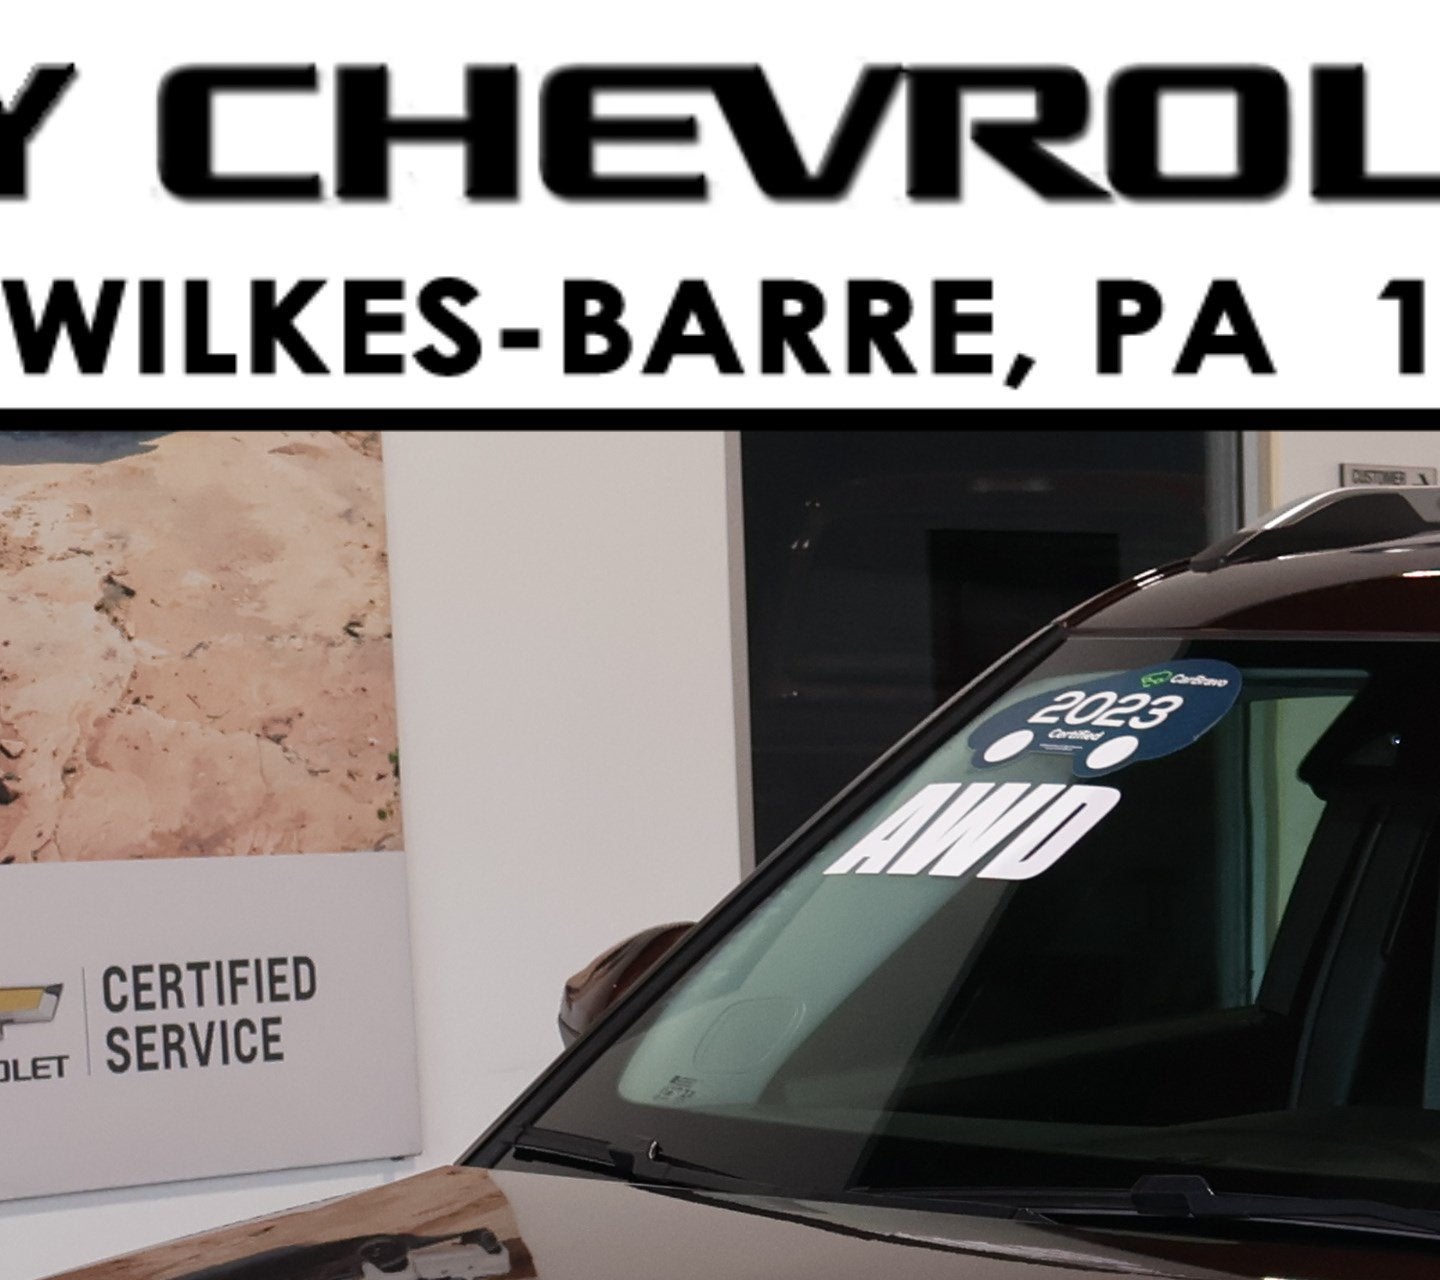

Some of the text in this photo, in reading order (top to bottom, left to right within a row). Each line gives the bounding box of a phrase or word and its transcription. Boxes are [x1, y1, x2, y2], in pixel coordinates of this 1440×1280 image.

[1026, 690, 1185, 730] 2023
[1048, 728, 1106, 741] Certified
[823, 782, 1122, 881] AWD
[101, 955, 317, 1014] CERTIFIED
[105, 1016, 285, 1075] SERVICE
